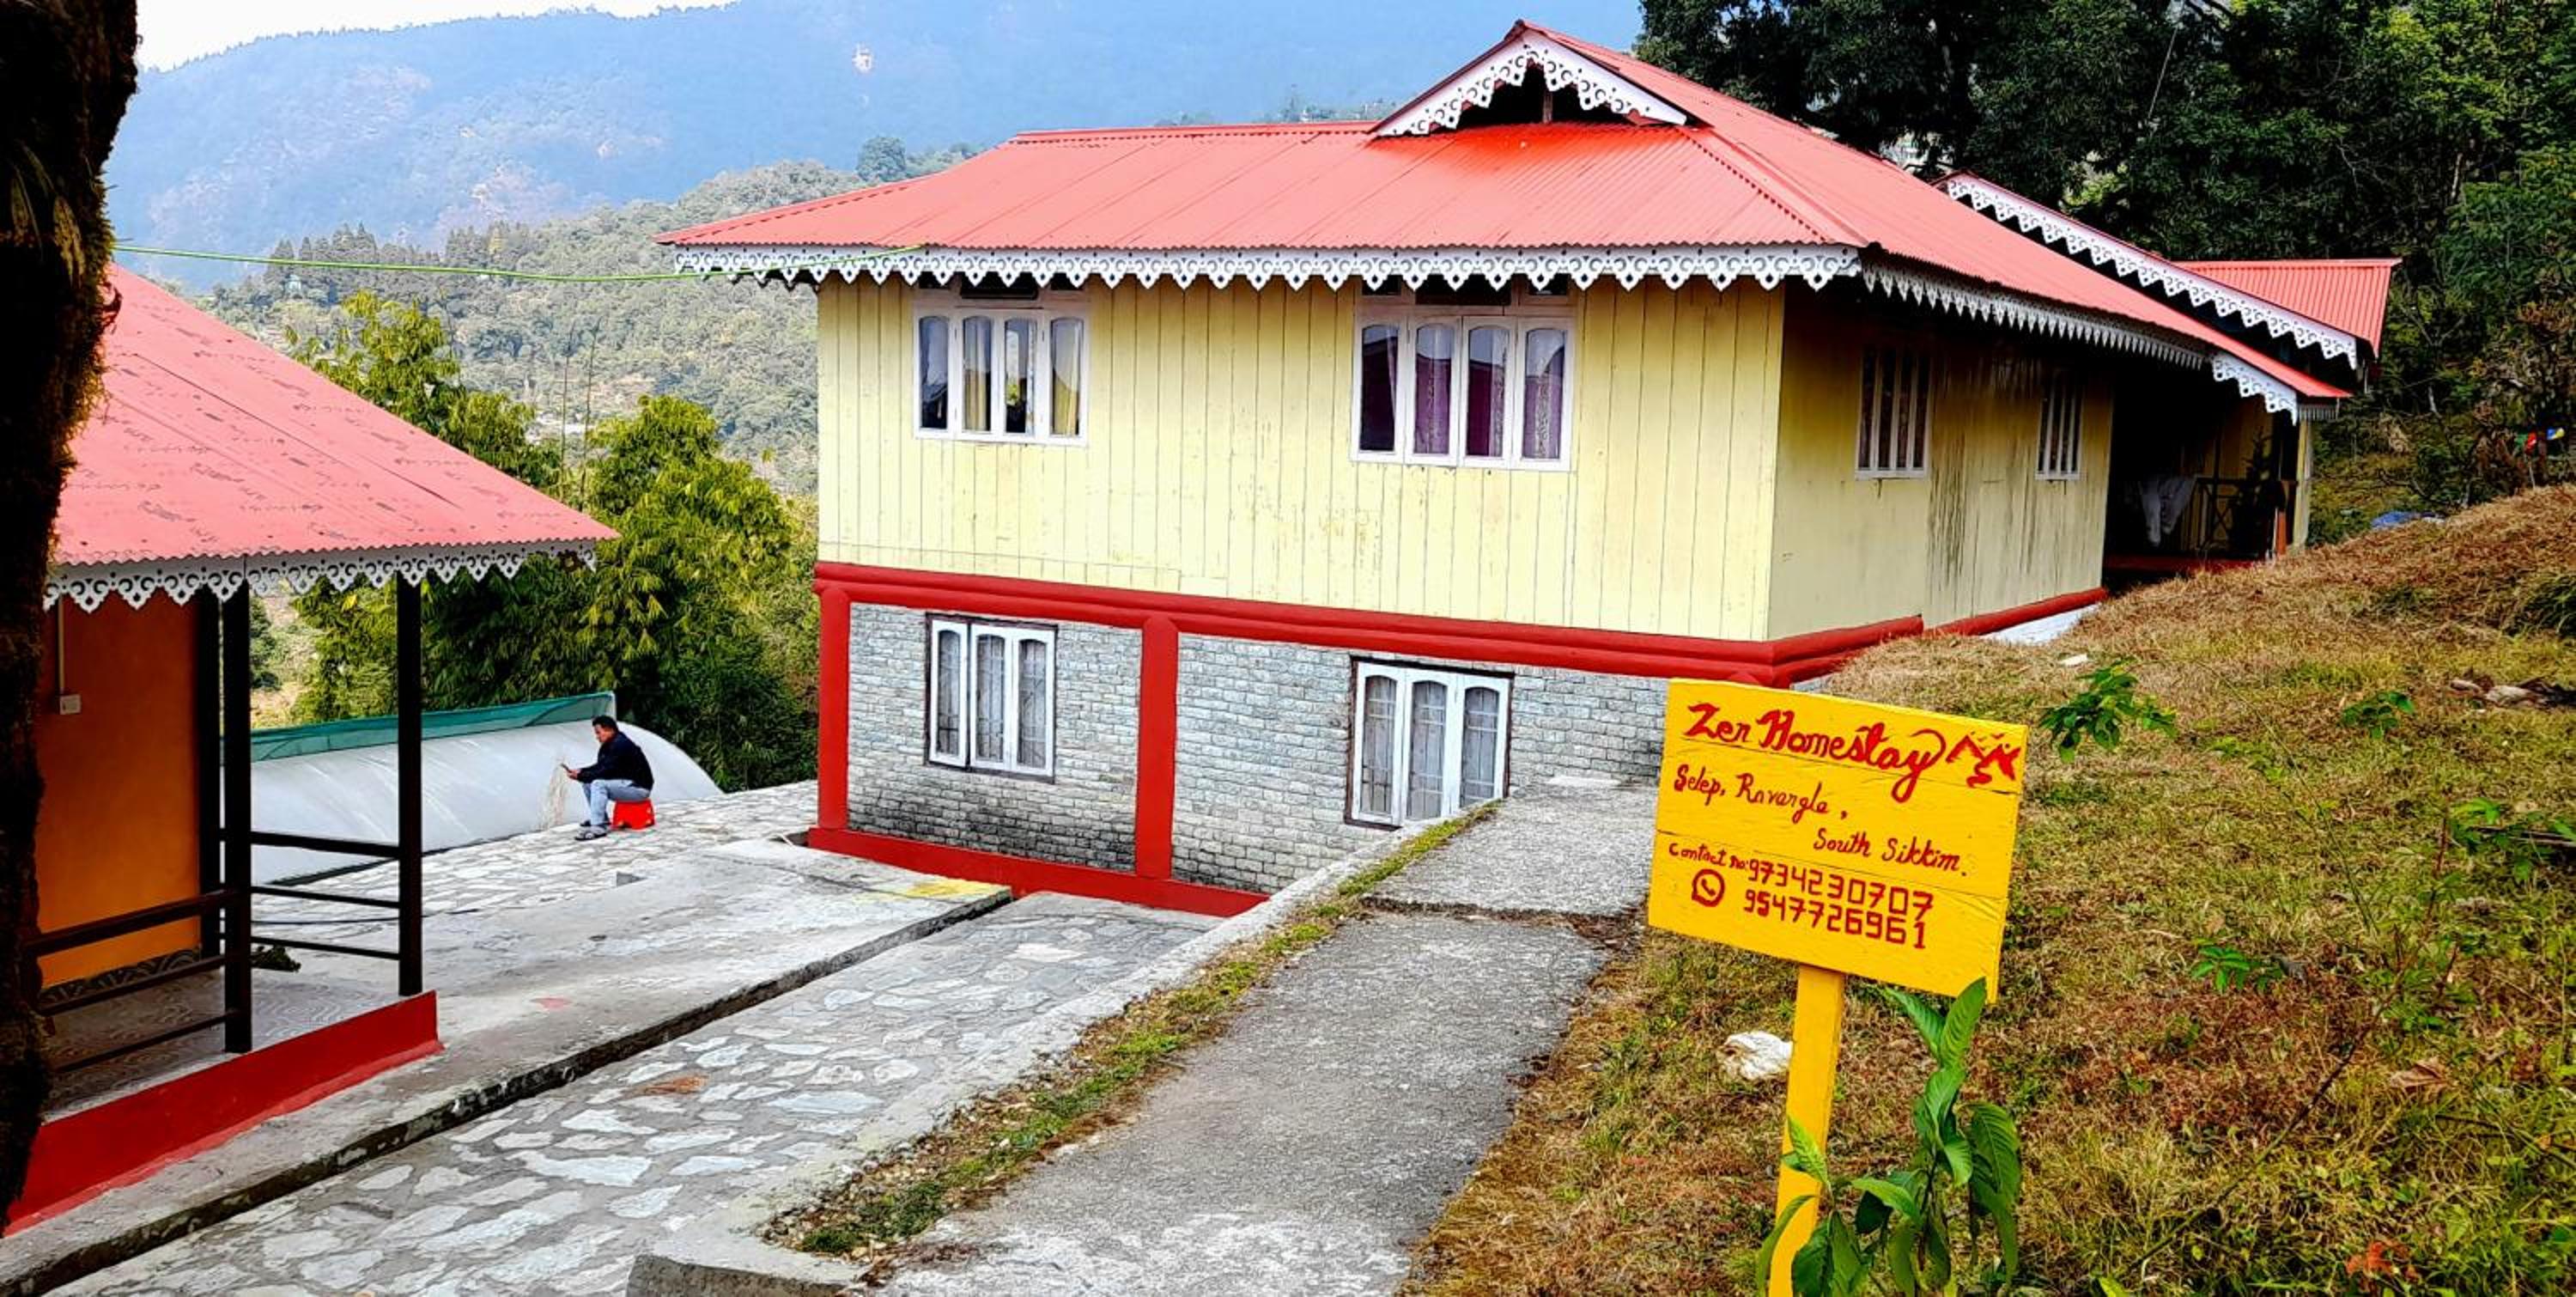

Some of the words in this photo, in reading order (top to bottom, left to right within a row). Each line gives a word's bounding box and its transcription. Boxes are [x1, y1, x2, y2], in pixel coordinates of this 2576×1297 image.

[1683, 703, 1752, 743] Zen
[1756, 709, 1947, 804] Homestay
[1814, 827, 1871, 858] South
[1744, 889, 1926, 950] 9547726961
[1748, 859, 1934, 922] 9734230707
